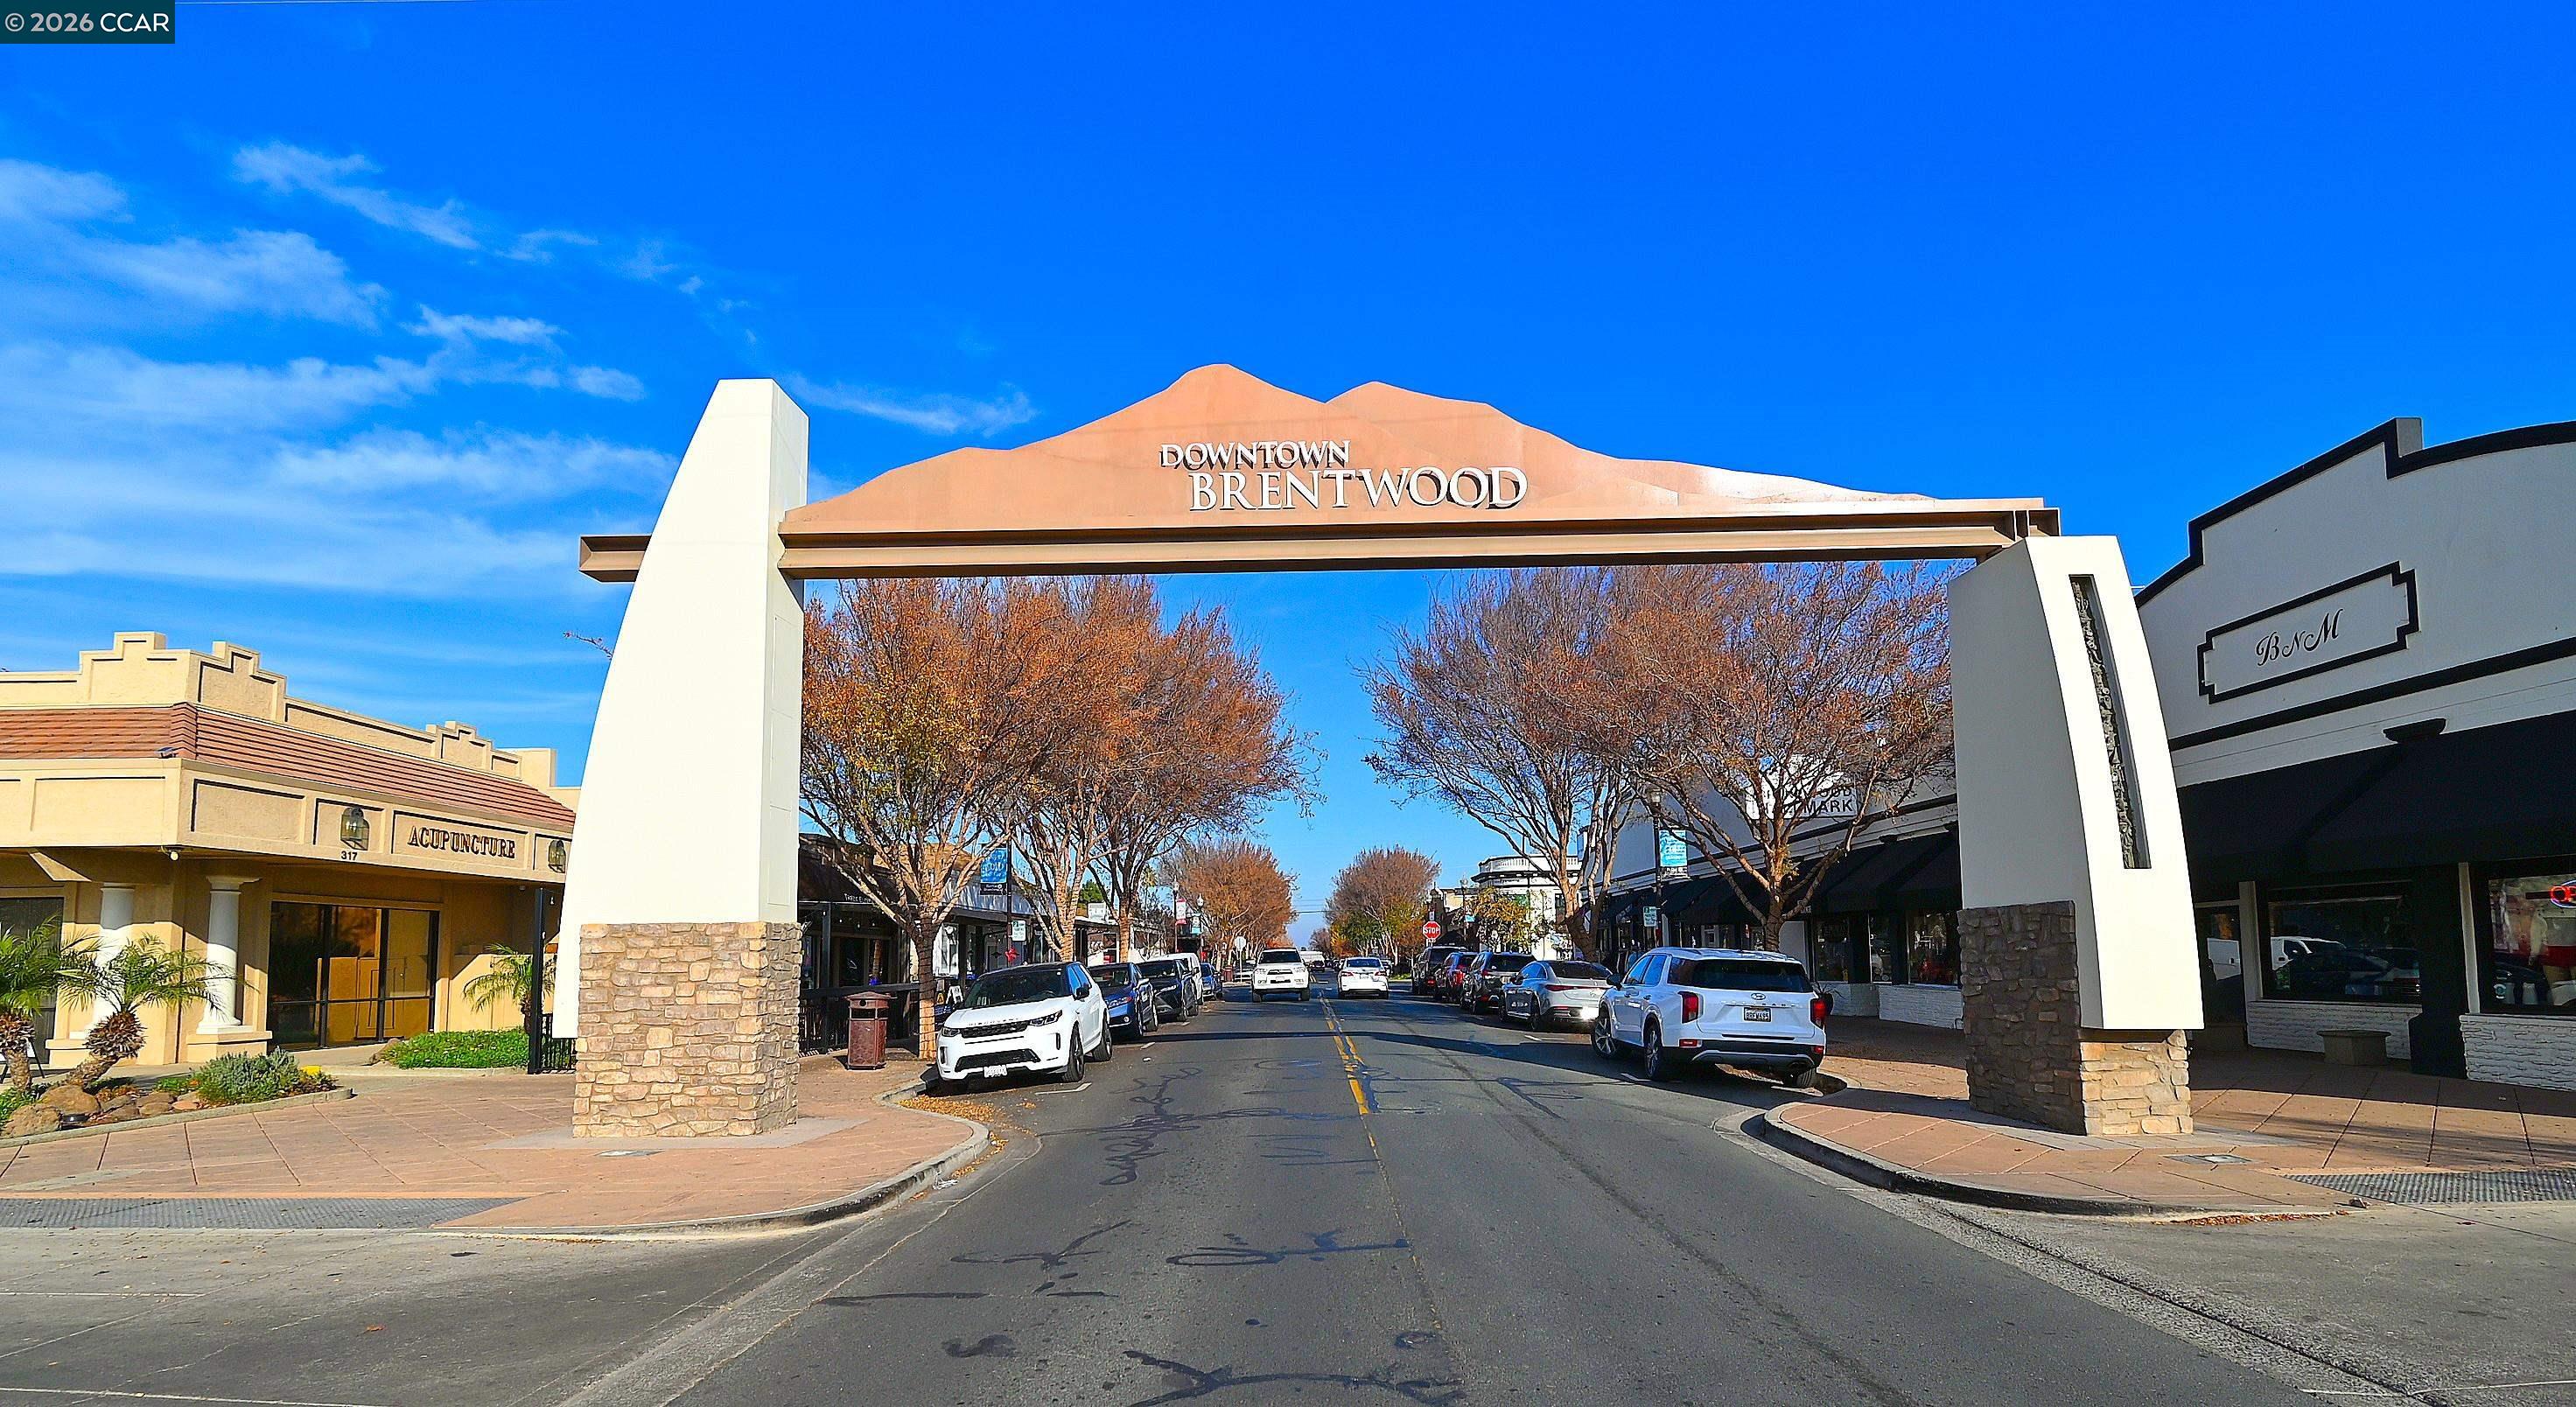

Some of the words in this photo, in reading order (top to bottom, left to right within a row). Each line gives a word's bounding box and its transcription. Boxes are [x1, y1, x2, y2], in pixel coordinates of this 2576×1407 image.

[1159, 440, 1350, 469] DOWNTOWN
[1188, 466, 1529, 511] BRENTWOOD
[341, 850, 358, 861] 317
[408, 825, 515, 859] ACUPUNCTURE
